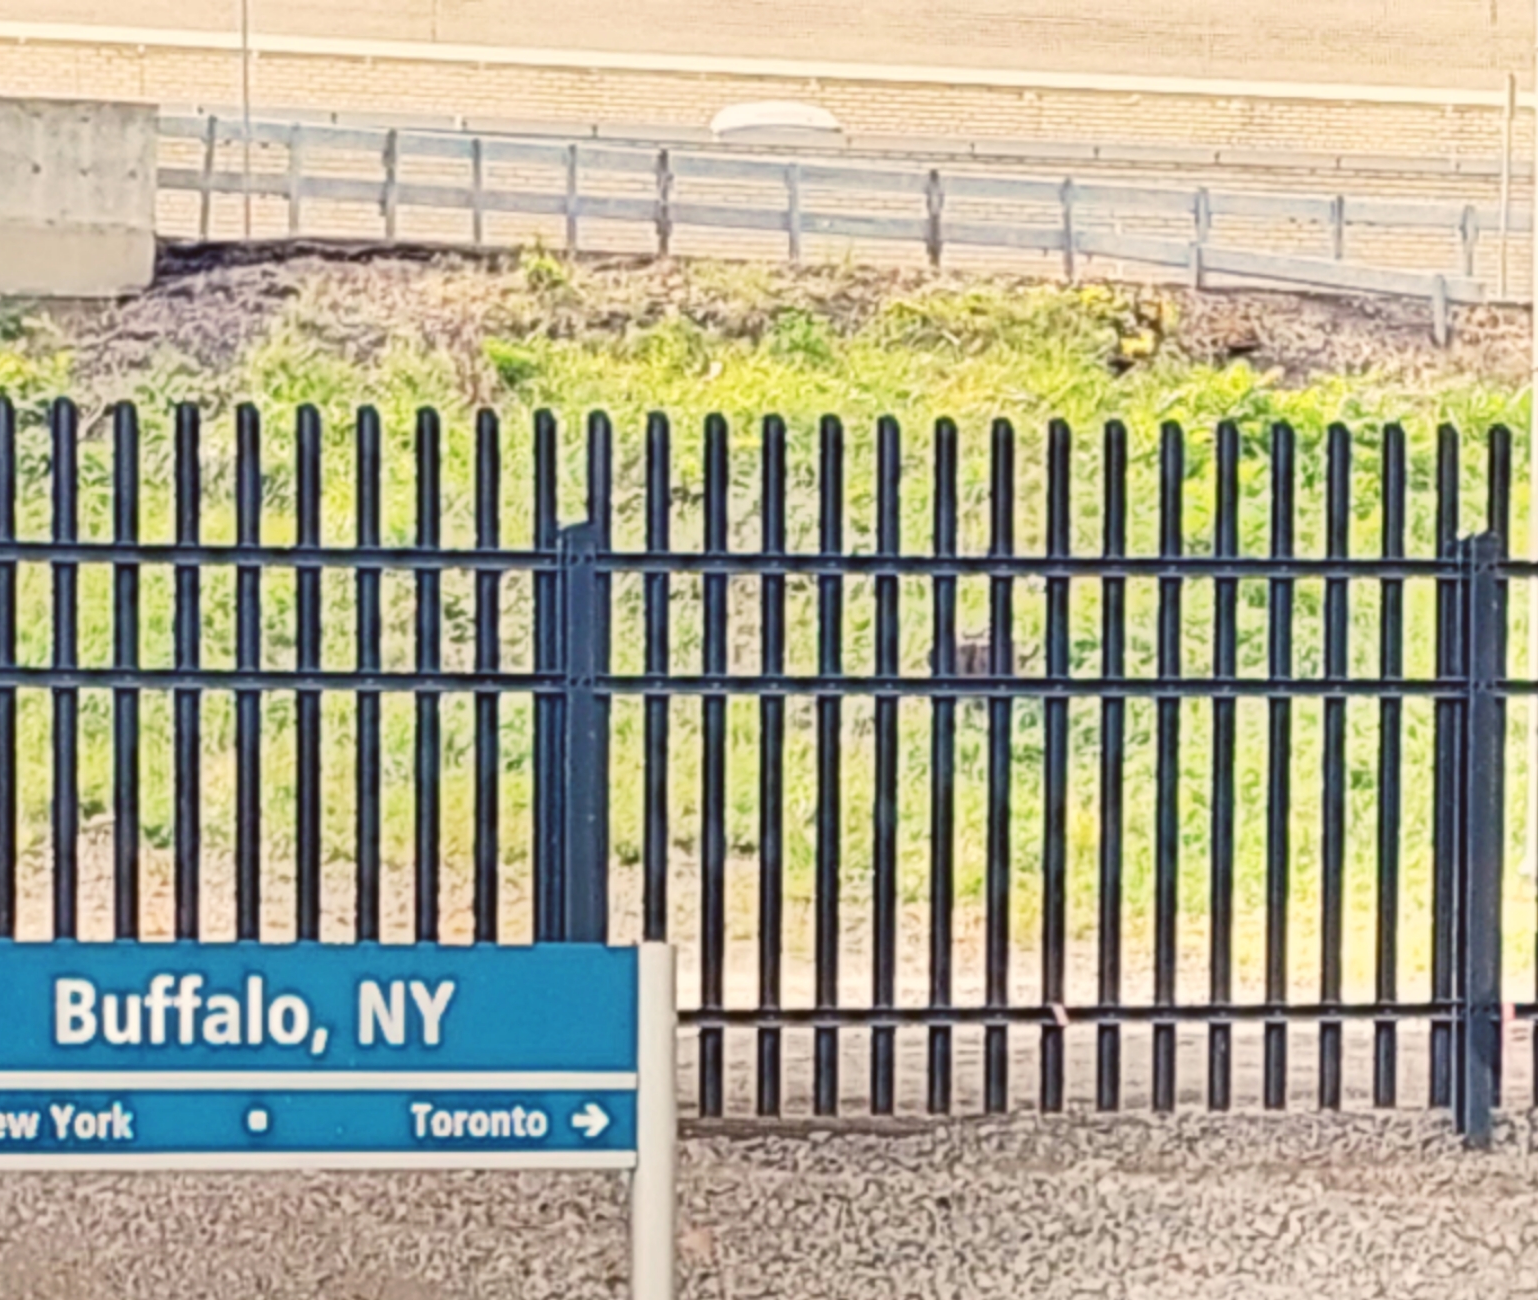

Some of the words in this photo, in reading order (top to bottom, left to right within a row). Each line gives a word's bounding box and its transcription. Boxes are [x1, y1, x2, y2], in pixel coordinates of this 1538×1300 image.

[54, 974, 329, 1055] Buffalo,
[358, 979, 456, 1046] NY
[49, 1102, 133, 1140] York
[410, 1102, 548, 1139] Toronto
